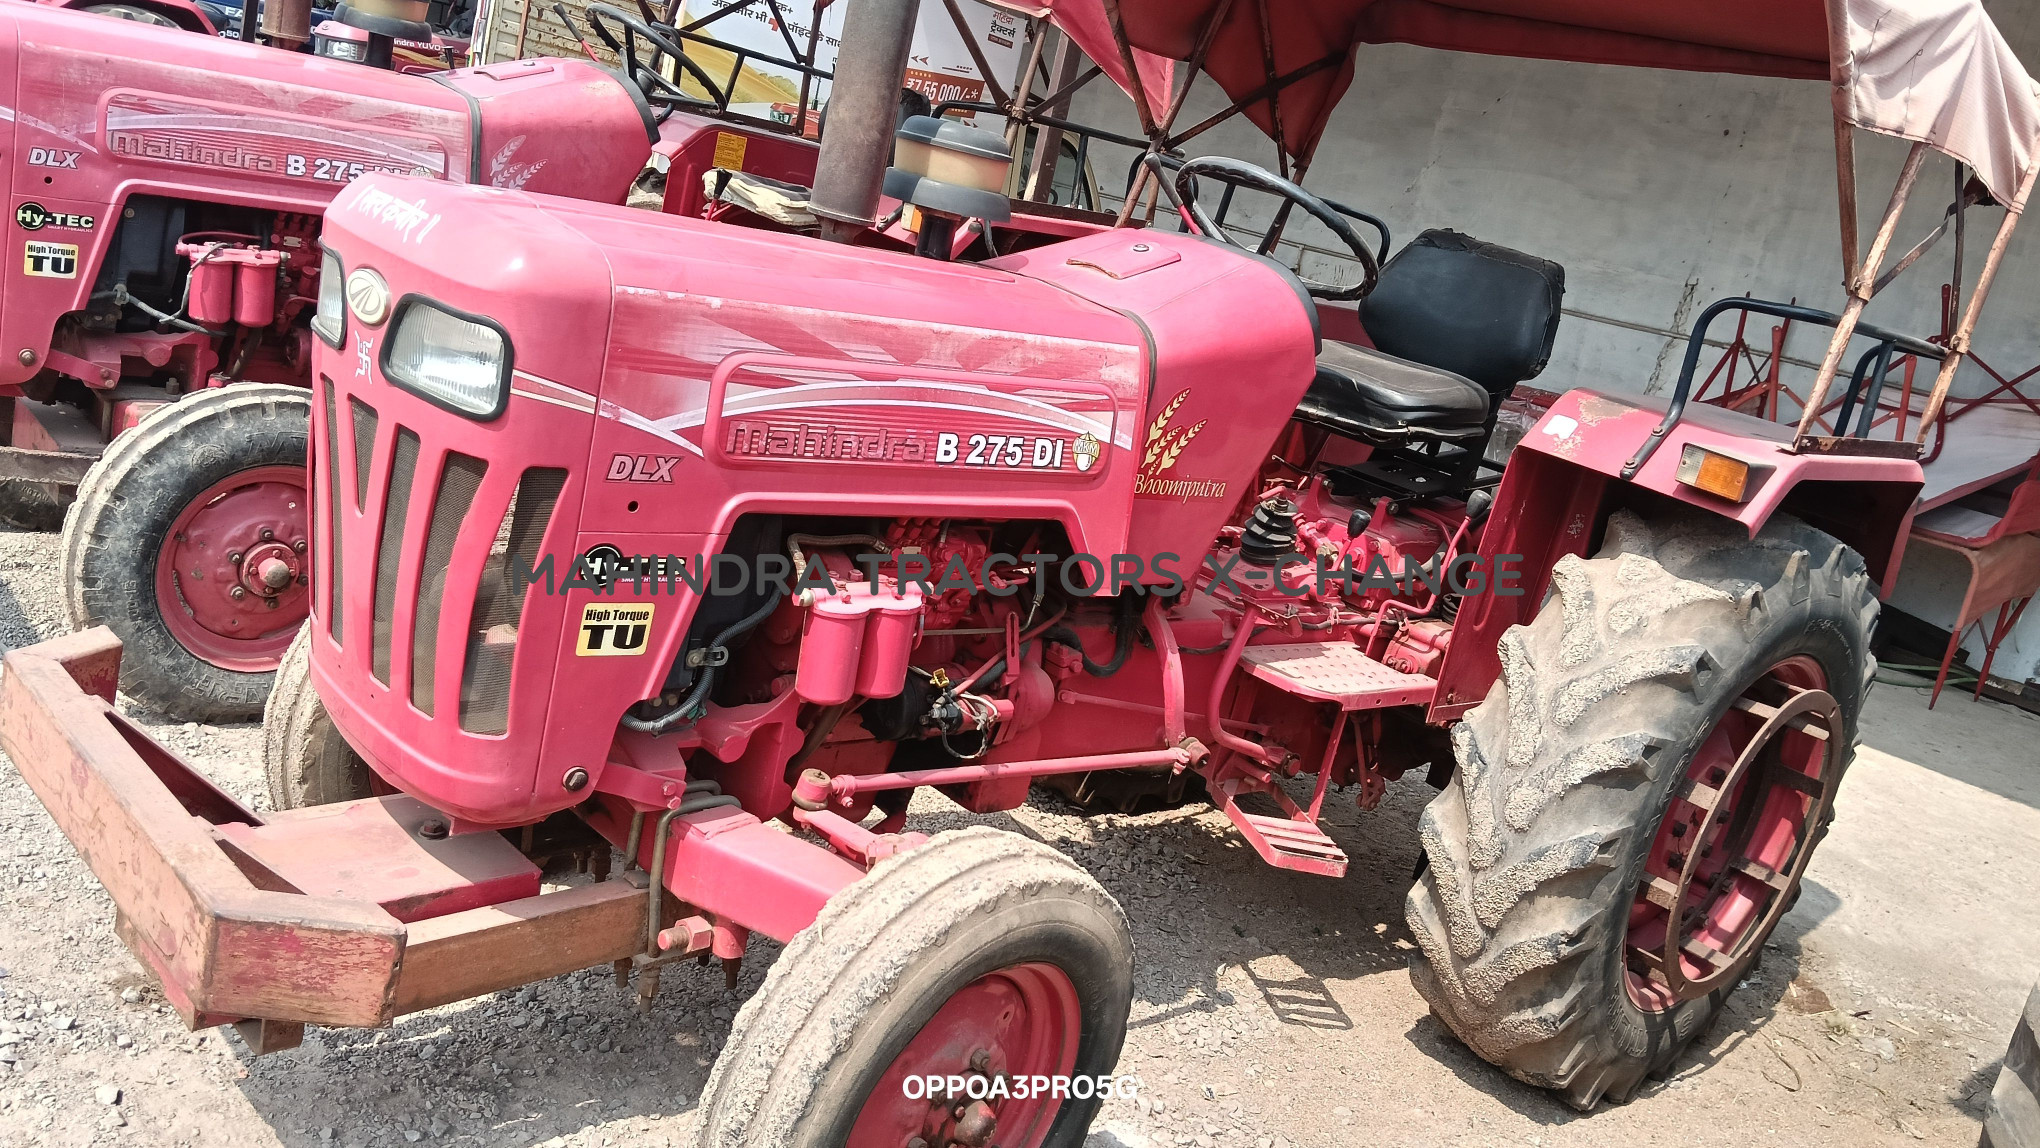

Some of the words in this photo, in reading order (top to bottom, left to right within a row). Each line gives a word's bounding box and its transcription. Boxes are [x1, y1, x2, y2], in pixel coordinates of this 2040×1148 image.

[755, 11, 768, 23] भी
[416, 41, 442, 51] YUVO
[28, 146, 82, 169] DLX
[112, 131, 277, 172] Mahindra
[286, 153, 307, 177] B
[313, 157, 365, 183] 275
[16, 208, 94, 228] Hy-TEC
[27, 244, 47, 254] High
[48, 246, 76, 256] Torque
[27, 254, 75, 275] TU
[725, 420, 926, 462] Mahindra
[935, 431, 961, 466] B
[965, 434, 1024, 468] 275
[1031, 438, 1065, 469] DI
[605, 453, 682, 484] DLX
[1133, 473, 1227, 504] Bhoomiputra
[584, 609, 611, 621] High
[613, 609, 650, 621] Torque
[582, 624, 648, 650] TU
